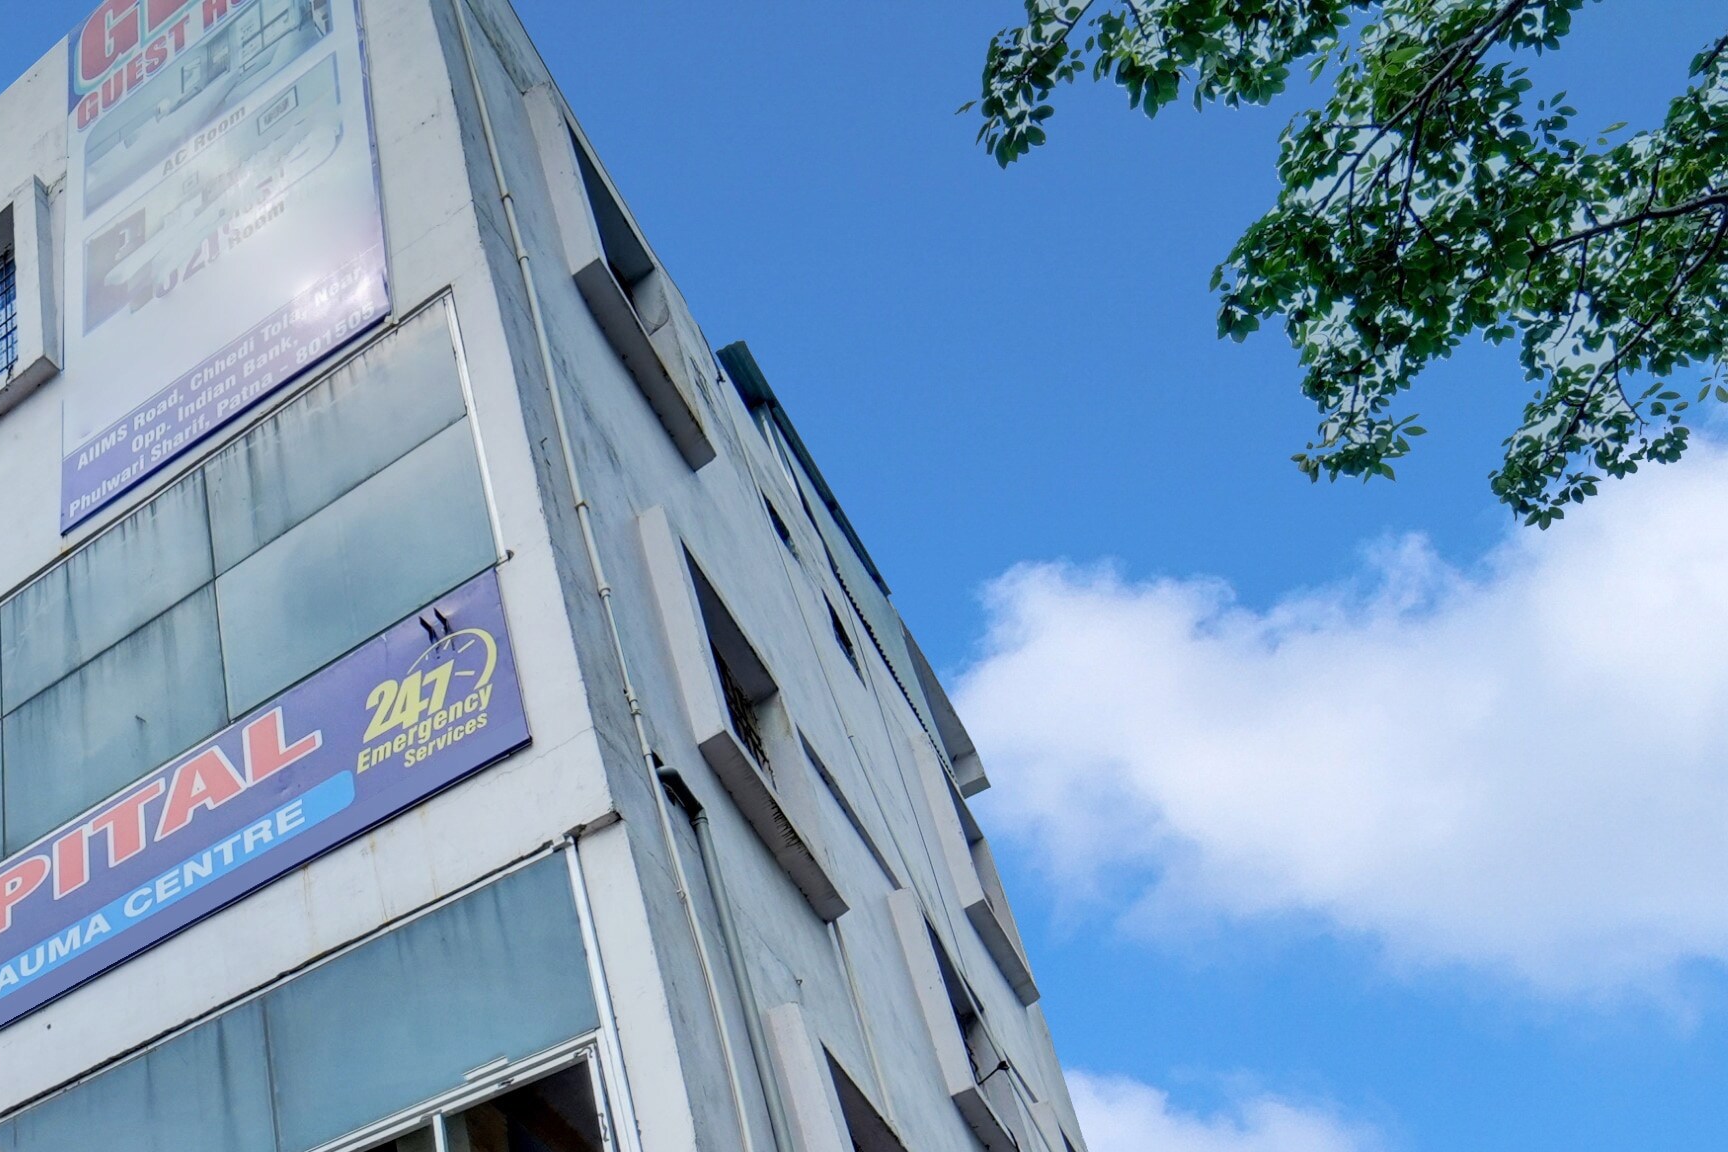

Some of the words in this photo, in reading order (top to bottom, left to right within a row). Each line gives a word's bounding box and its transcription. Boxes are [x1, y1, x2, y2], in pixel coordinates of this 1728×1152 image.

[76, 13, 190, 132] GUEST
[161, 146, 188, 177] AC
[193, 105, 247, 151] Room
[69, 452, 145, 517] Phulwari
[151, 414, 210, 461] Sharif,
[217, 374, 273, 417] Patna
[295, 303, 375, 366] 801505
[77, 424, 127, 471] AIIMS
[134, 388, 184, 429] Road,
[190, 337, 254, 390] Chhedi
[314, 266, 363, 306] Near
[131, 421, 171, 453] Opp.
[178, 375, 236, 425] Indian
[243, 337, 299, 378] Bank,
[356, 684, 493, 774] Emergency
[404, 713, 488, 768] Services
[123, 798, 307, 918] CENTRE
